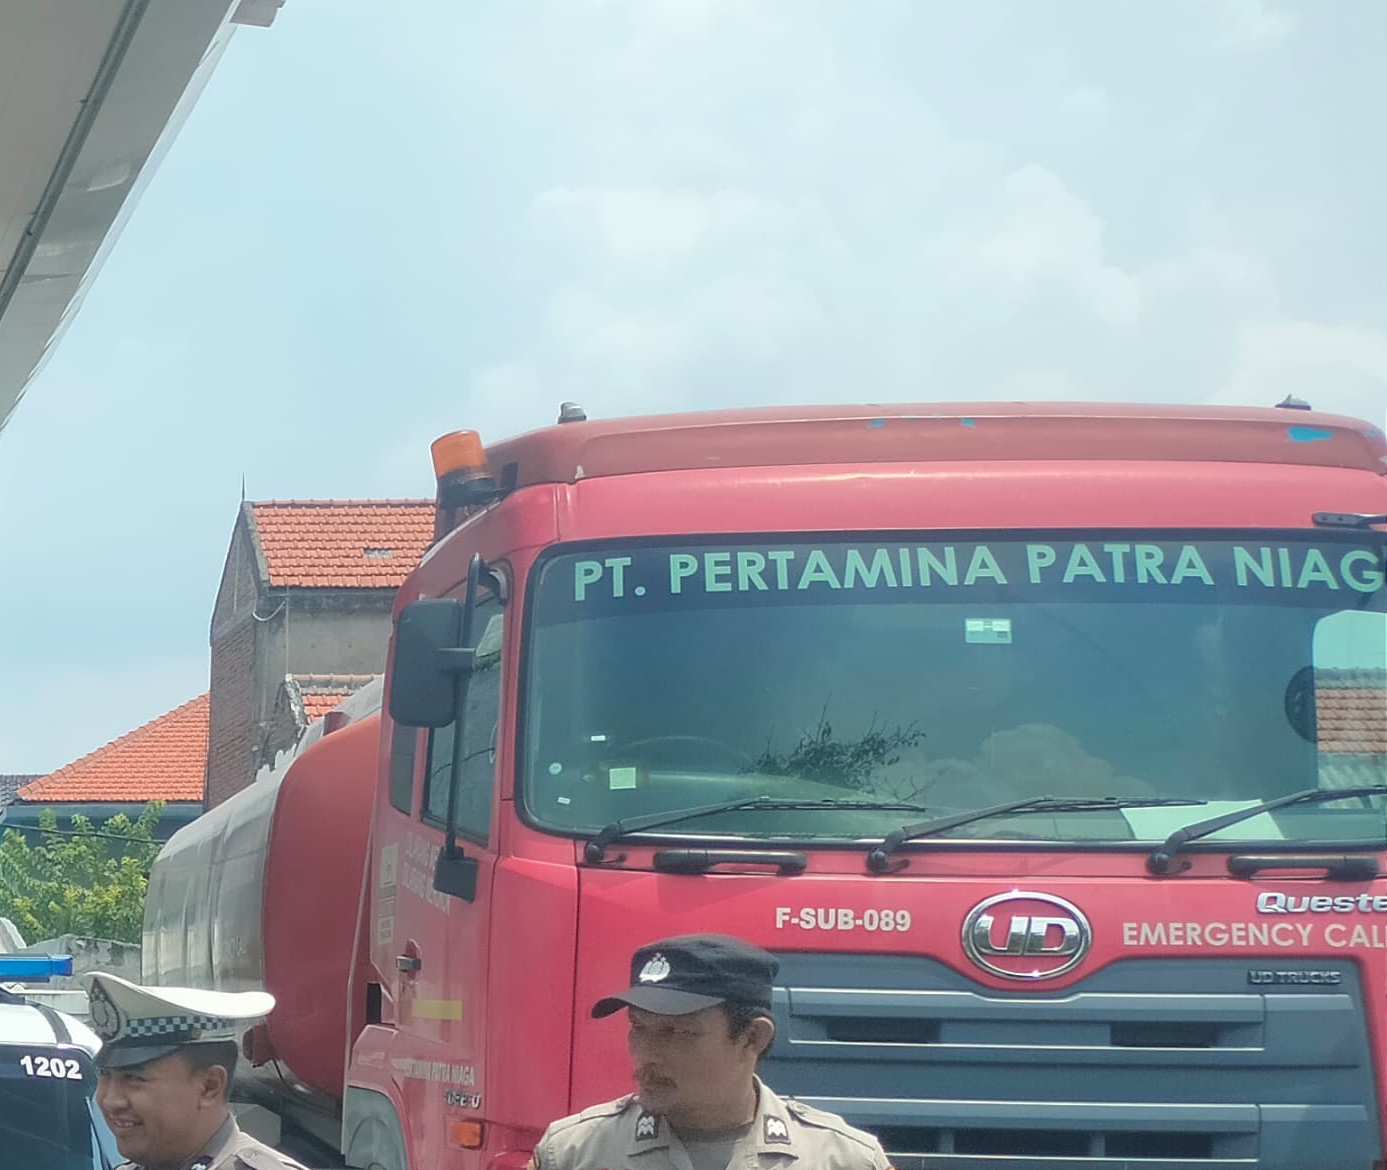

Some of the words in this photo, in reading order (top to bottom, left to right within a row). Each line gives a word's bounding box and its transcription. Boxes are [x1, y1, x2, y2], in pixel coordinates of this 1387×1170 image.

[574, 558, 646, 601] PT.
[670, 545, 1008, 594] PERTAMINA
[1028, 543, 1215, 585] PATRA
[1233, 546, 1385, 593] NIAG
[1256, 891, 1387, 914] Queste
[775, 907, 912, 932] F-SUB-089
[974, 915, 1081, 956] UD
[1122, 922, 1314, 947] EMERGENCY
[1324, 923, 1387, 948] CAL
[1277, 970, 1342, 984] TRUCKS
[20, 1055, 83, 1080] 1202
